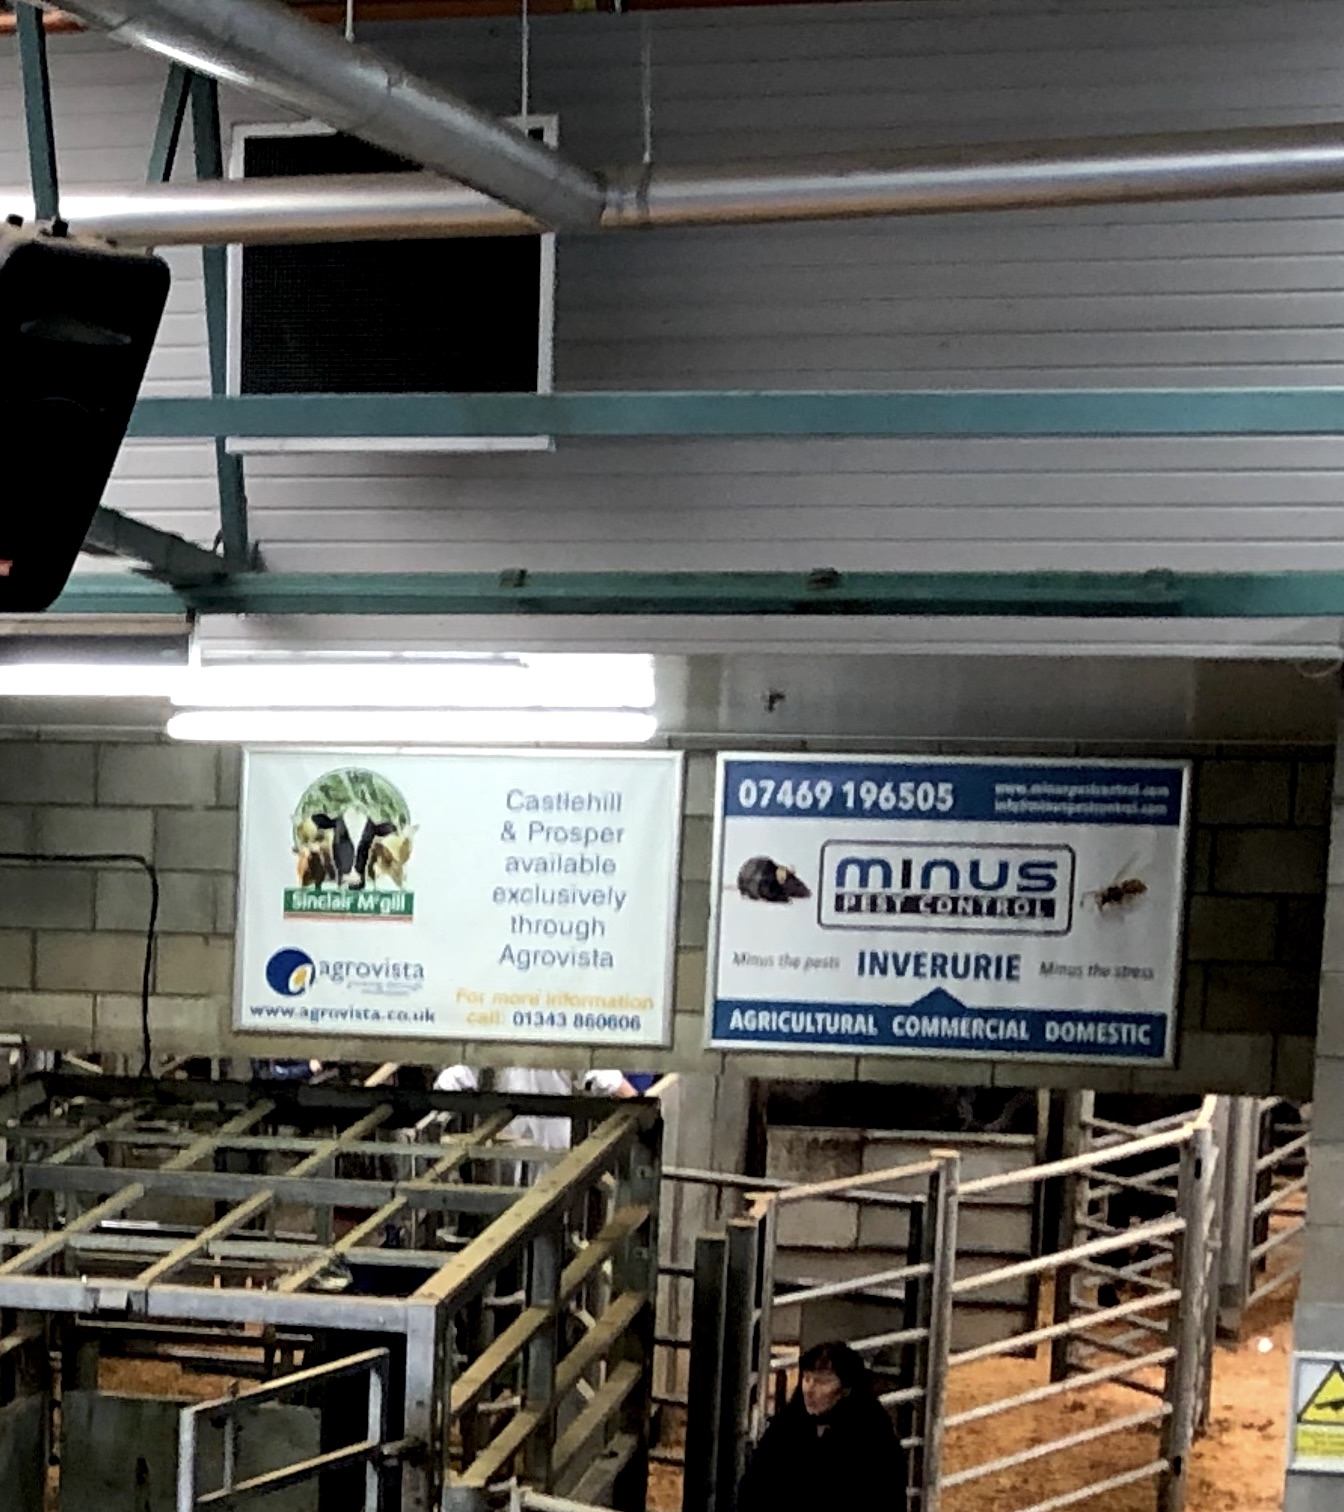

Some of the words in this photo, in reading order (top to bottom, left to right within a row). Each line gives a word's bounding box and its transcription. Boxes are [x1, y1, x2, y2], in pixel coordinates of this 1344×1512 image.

[506, 788, 623, 813] Castlehill
[739, 778, 832, 811] 07469
[842, 780, 954, 812] 196505
[501, 821, 515, 842] &
[529, 820, 625, 847] Prosper
[505, 853, 617, 875] available
[292, 889, 354, 910] Sinclair
[492, 884, 627, 911] exclusively
[919, 896, 1050, 918] CONTROL
[510, 915, 606, 941] through
[319, 958, 424, 982] agrovista
[499, 944, 614, 971] Agrovista
[858, 950, 1021, 981] INVERURIE
[456, 987, 484, 1004] For
[492, 991, 540, 1006] more
[545, 992, 654, 1011] information
[250, 1004, 436, 1024] www.agrovista.co.uk
[729, 1008, 878, 1036] AGRICULTURAL
[892, 1014, 1030, 1041] COMMERCIAL
[1045, 1021, 1152, 1045] DOMESTIC
